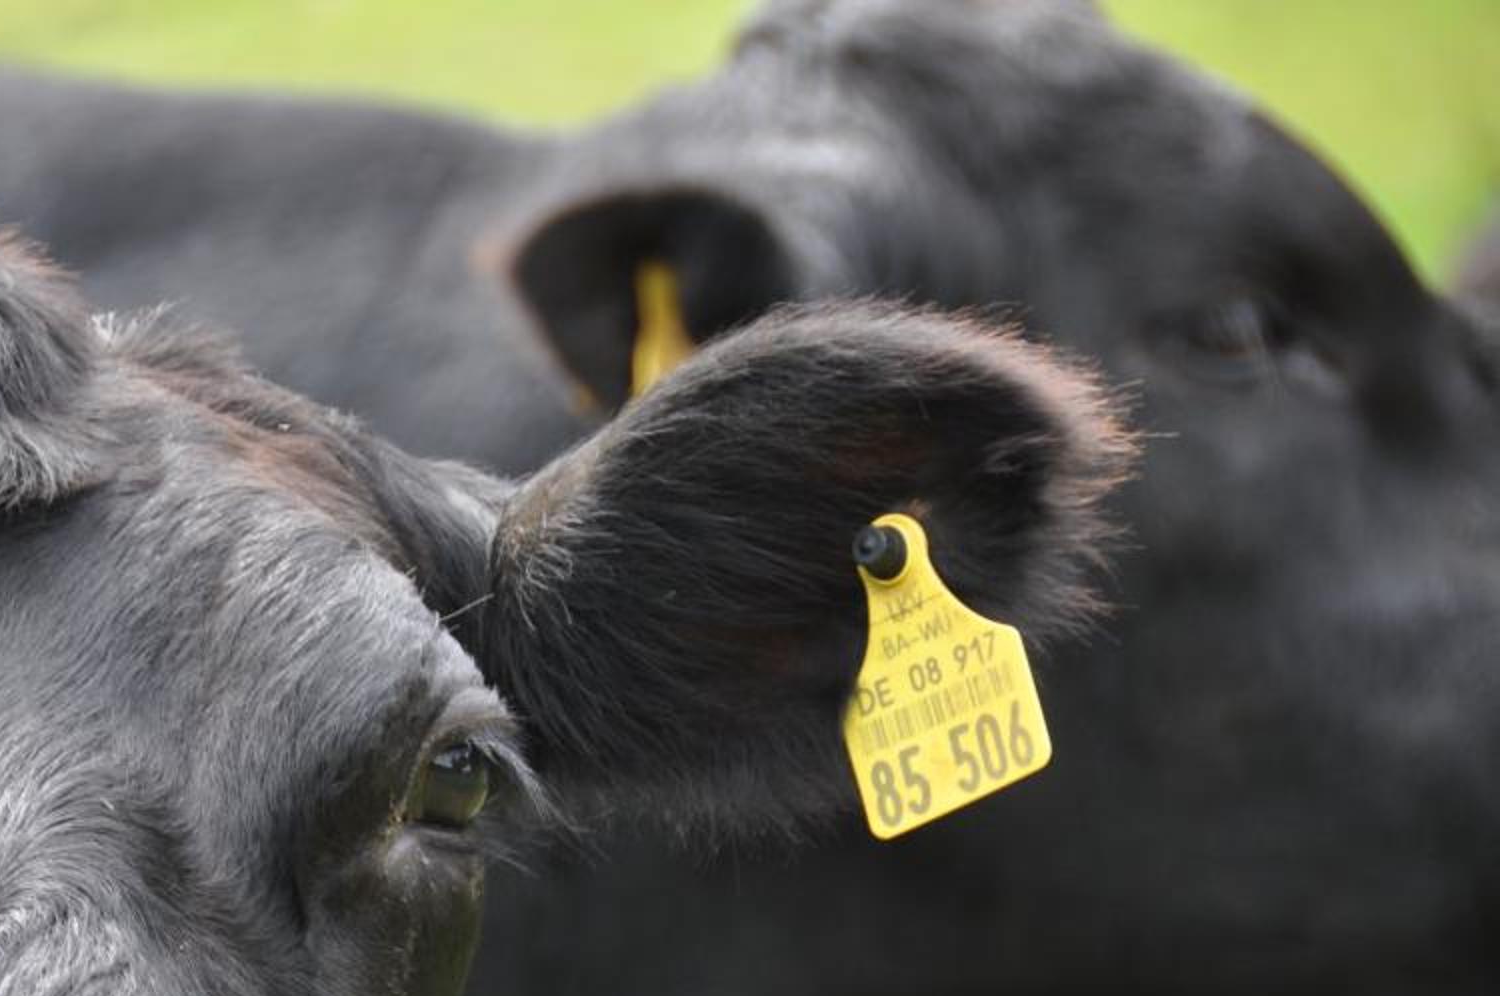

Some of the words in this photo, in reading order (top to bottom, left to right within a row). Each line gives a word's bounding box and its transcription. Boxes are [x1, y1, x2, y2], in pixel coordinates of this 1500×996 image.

[856, 678, 893, 717] DE
[908, 657, 942, 693] 08
[953, 631, 996, 673] 917
[870, 744, 931, 828] 85
[949, 701, 1035, 794] 506
